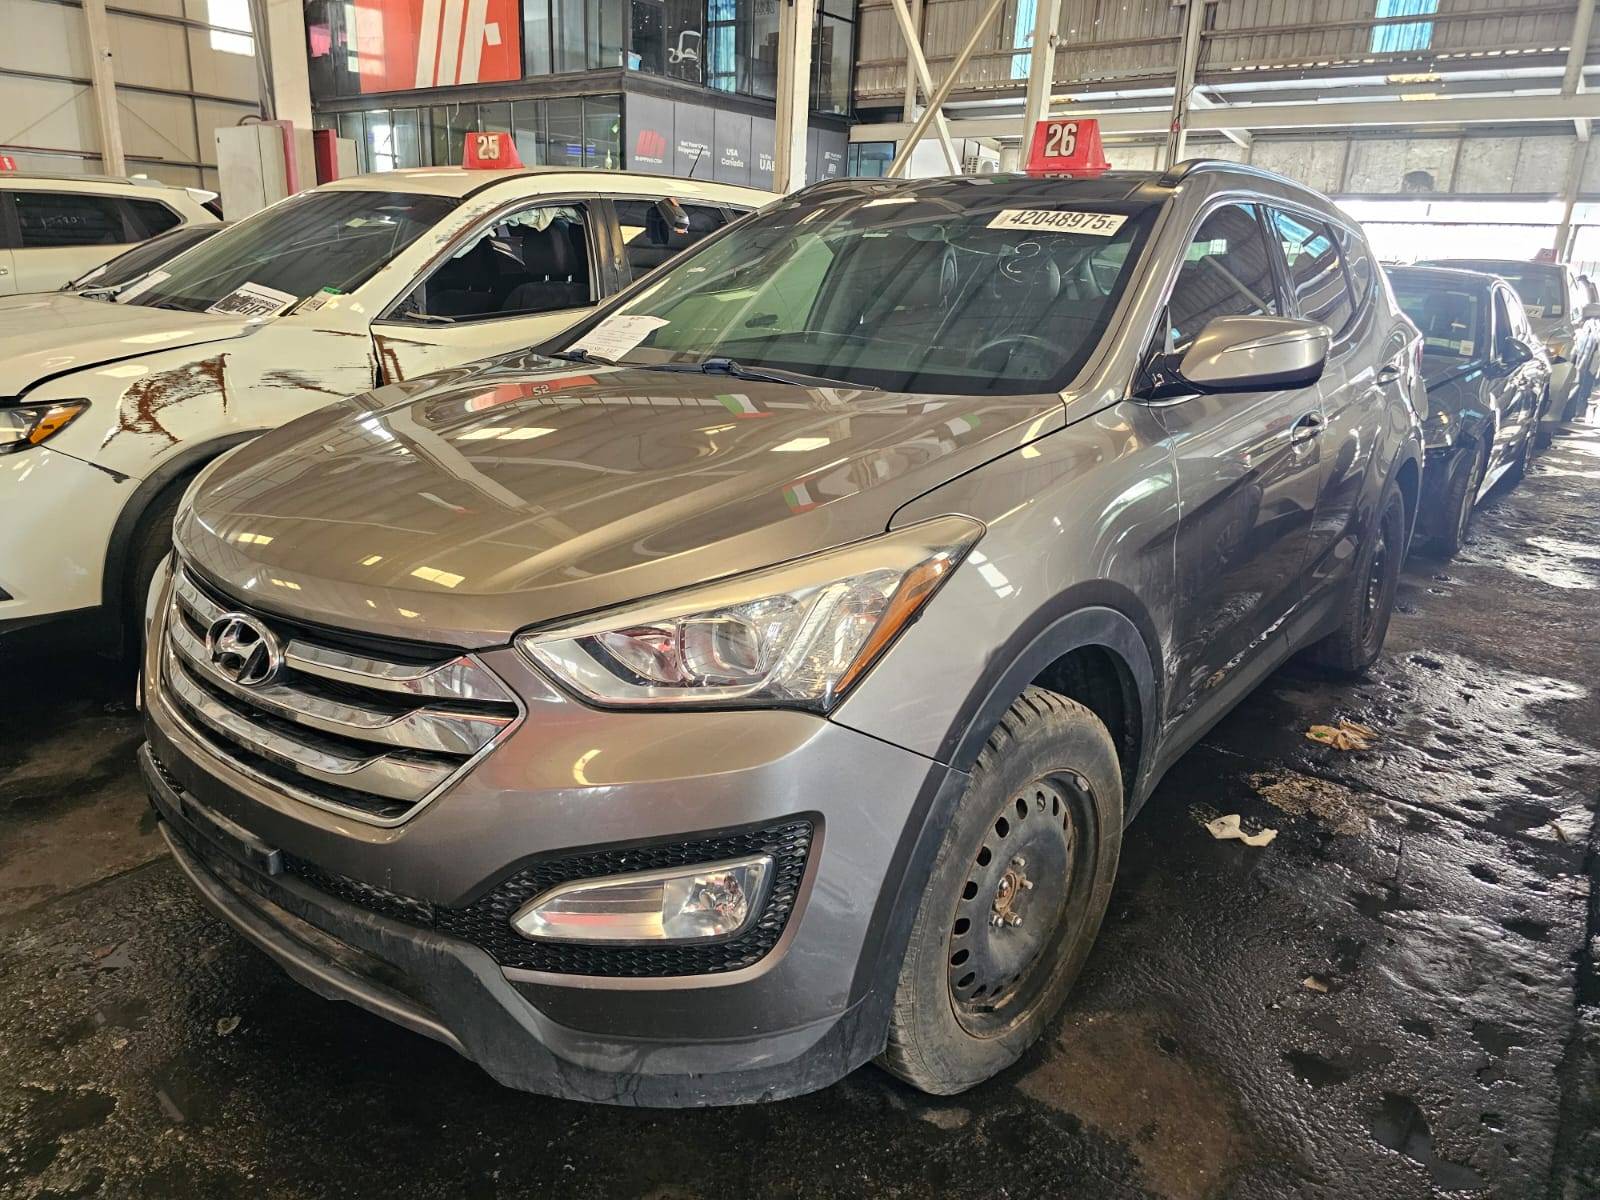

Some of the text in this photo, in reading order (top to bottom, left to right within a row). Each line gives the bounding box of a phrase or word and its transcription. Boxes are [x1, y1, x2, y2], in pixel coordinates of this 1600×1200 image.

[477, 135, 500, 160] 25
[1045, 123, 1078, 157] 26
[726, 148, 738, 156] USA
[1009, 210, 1112, 230] 42048975
